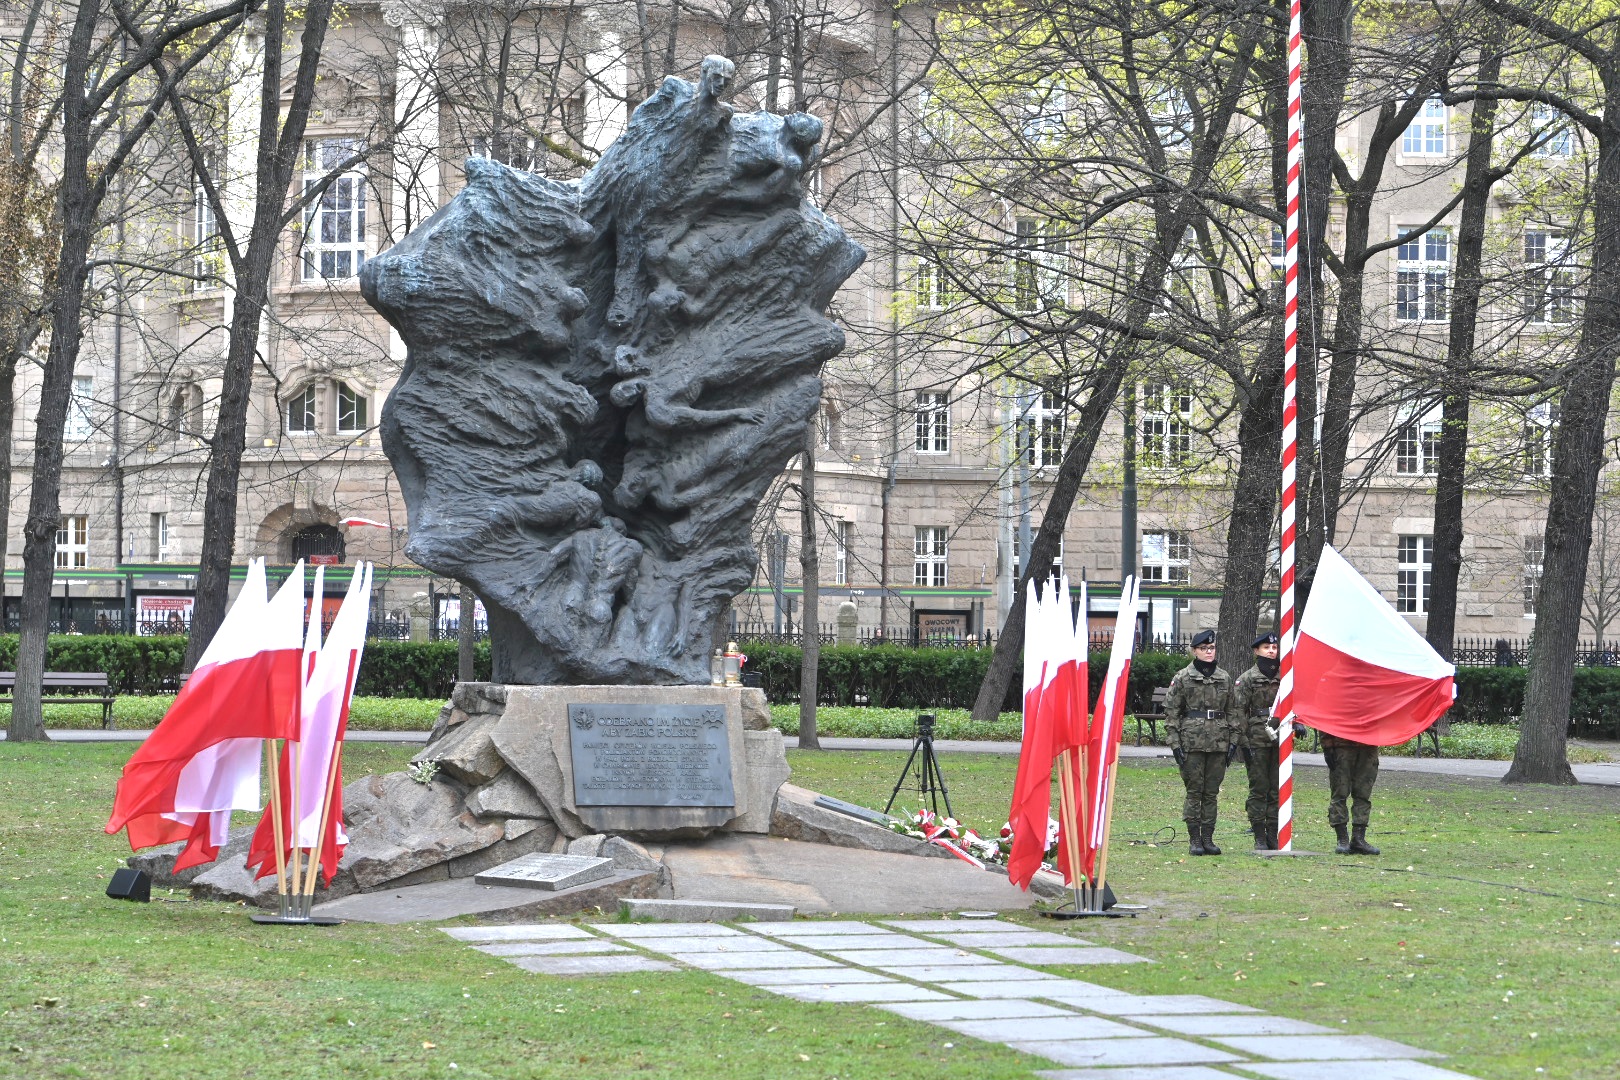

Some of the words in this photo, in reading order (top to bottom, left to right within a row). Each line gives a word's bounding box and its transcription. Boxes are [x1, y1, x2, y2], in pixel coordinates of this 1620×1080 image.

[925, 618, 960, 626] OWOCOWY
[597, 717, 655, 727] ODEBRANO
[657, 717, 670, 727] IM
[602, 728, 621, 738] ABY
